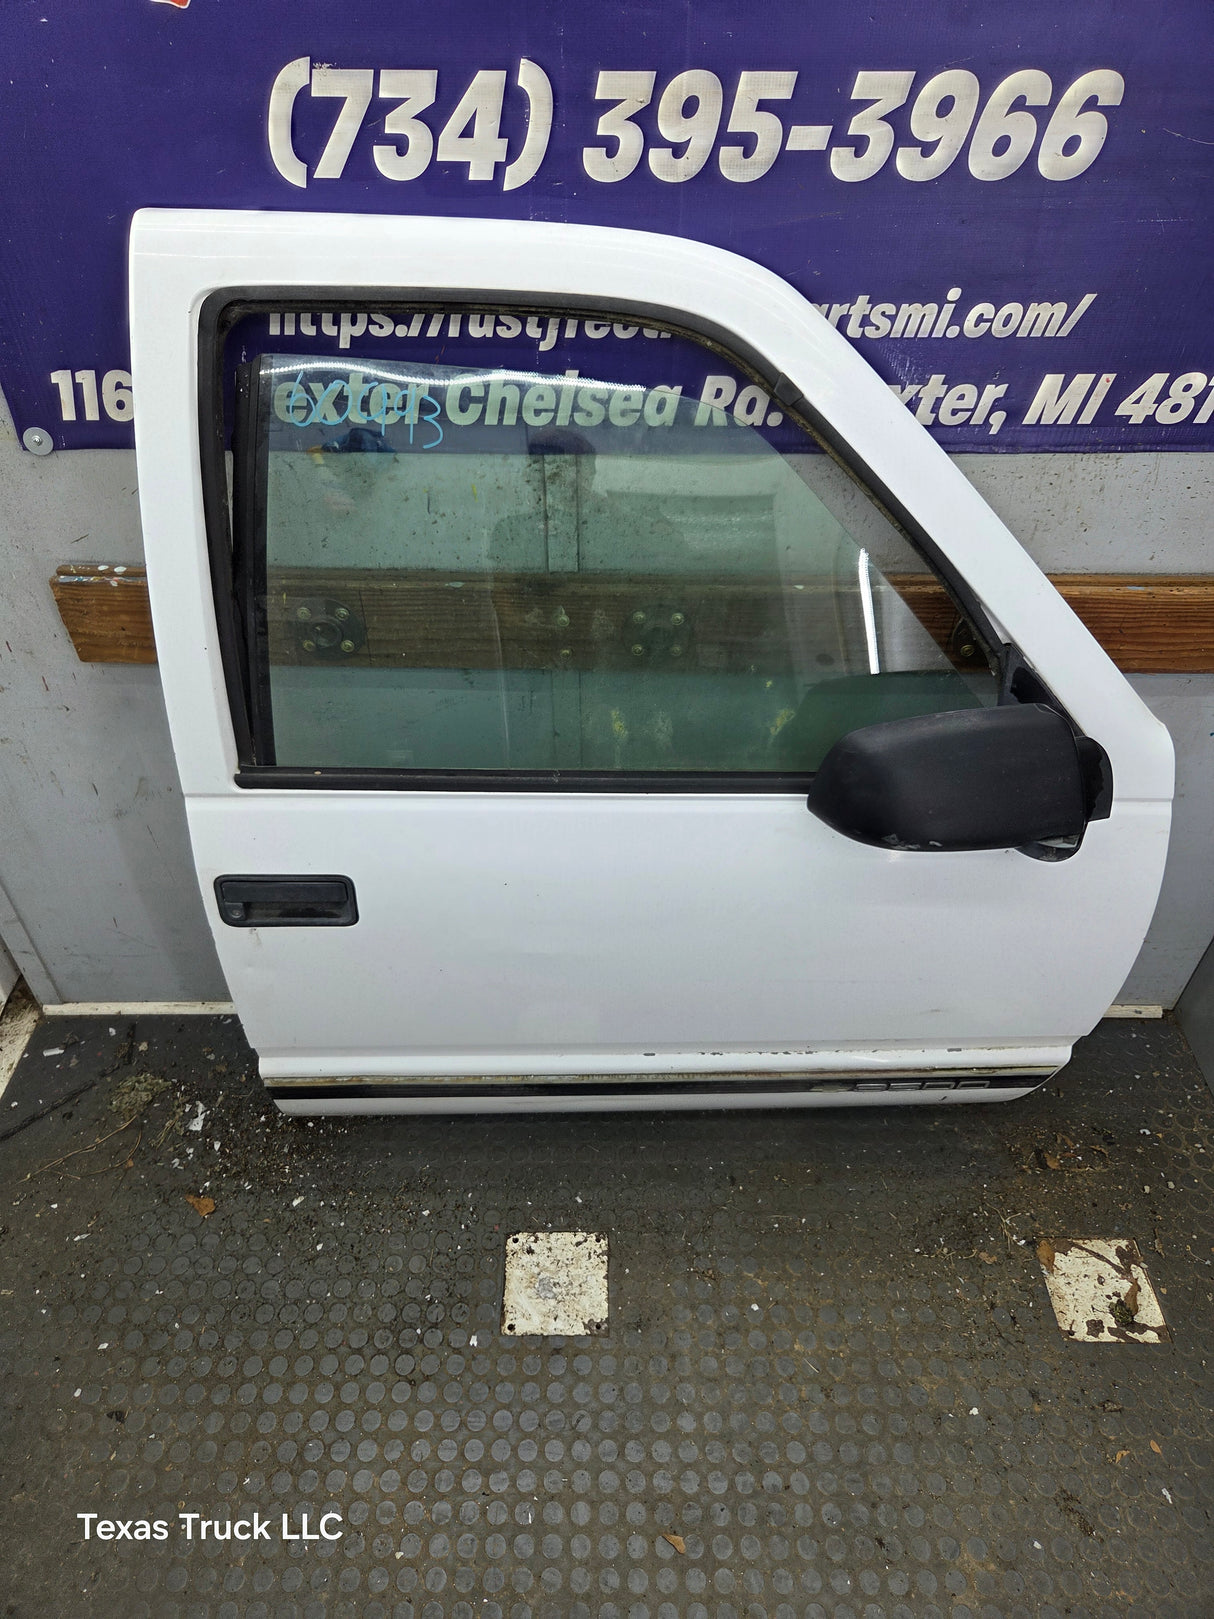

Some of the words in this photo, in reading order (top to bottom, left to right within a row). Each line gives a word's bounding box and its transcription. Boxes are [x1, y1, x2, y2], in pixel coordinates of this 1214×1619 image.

[268, 56, 554, 192] (734)
[583, 69, 1124, 183] 395-3966
[446, 370, 683, 427] Chelsea
[1022, 373, 1117, 425] MI
